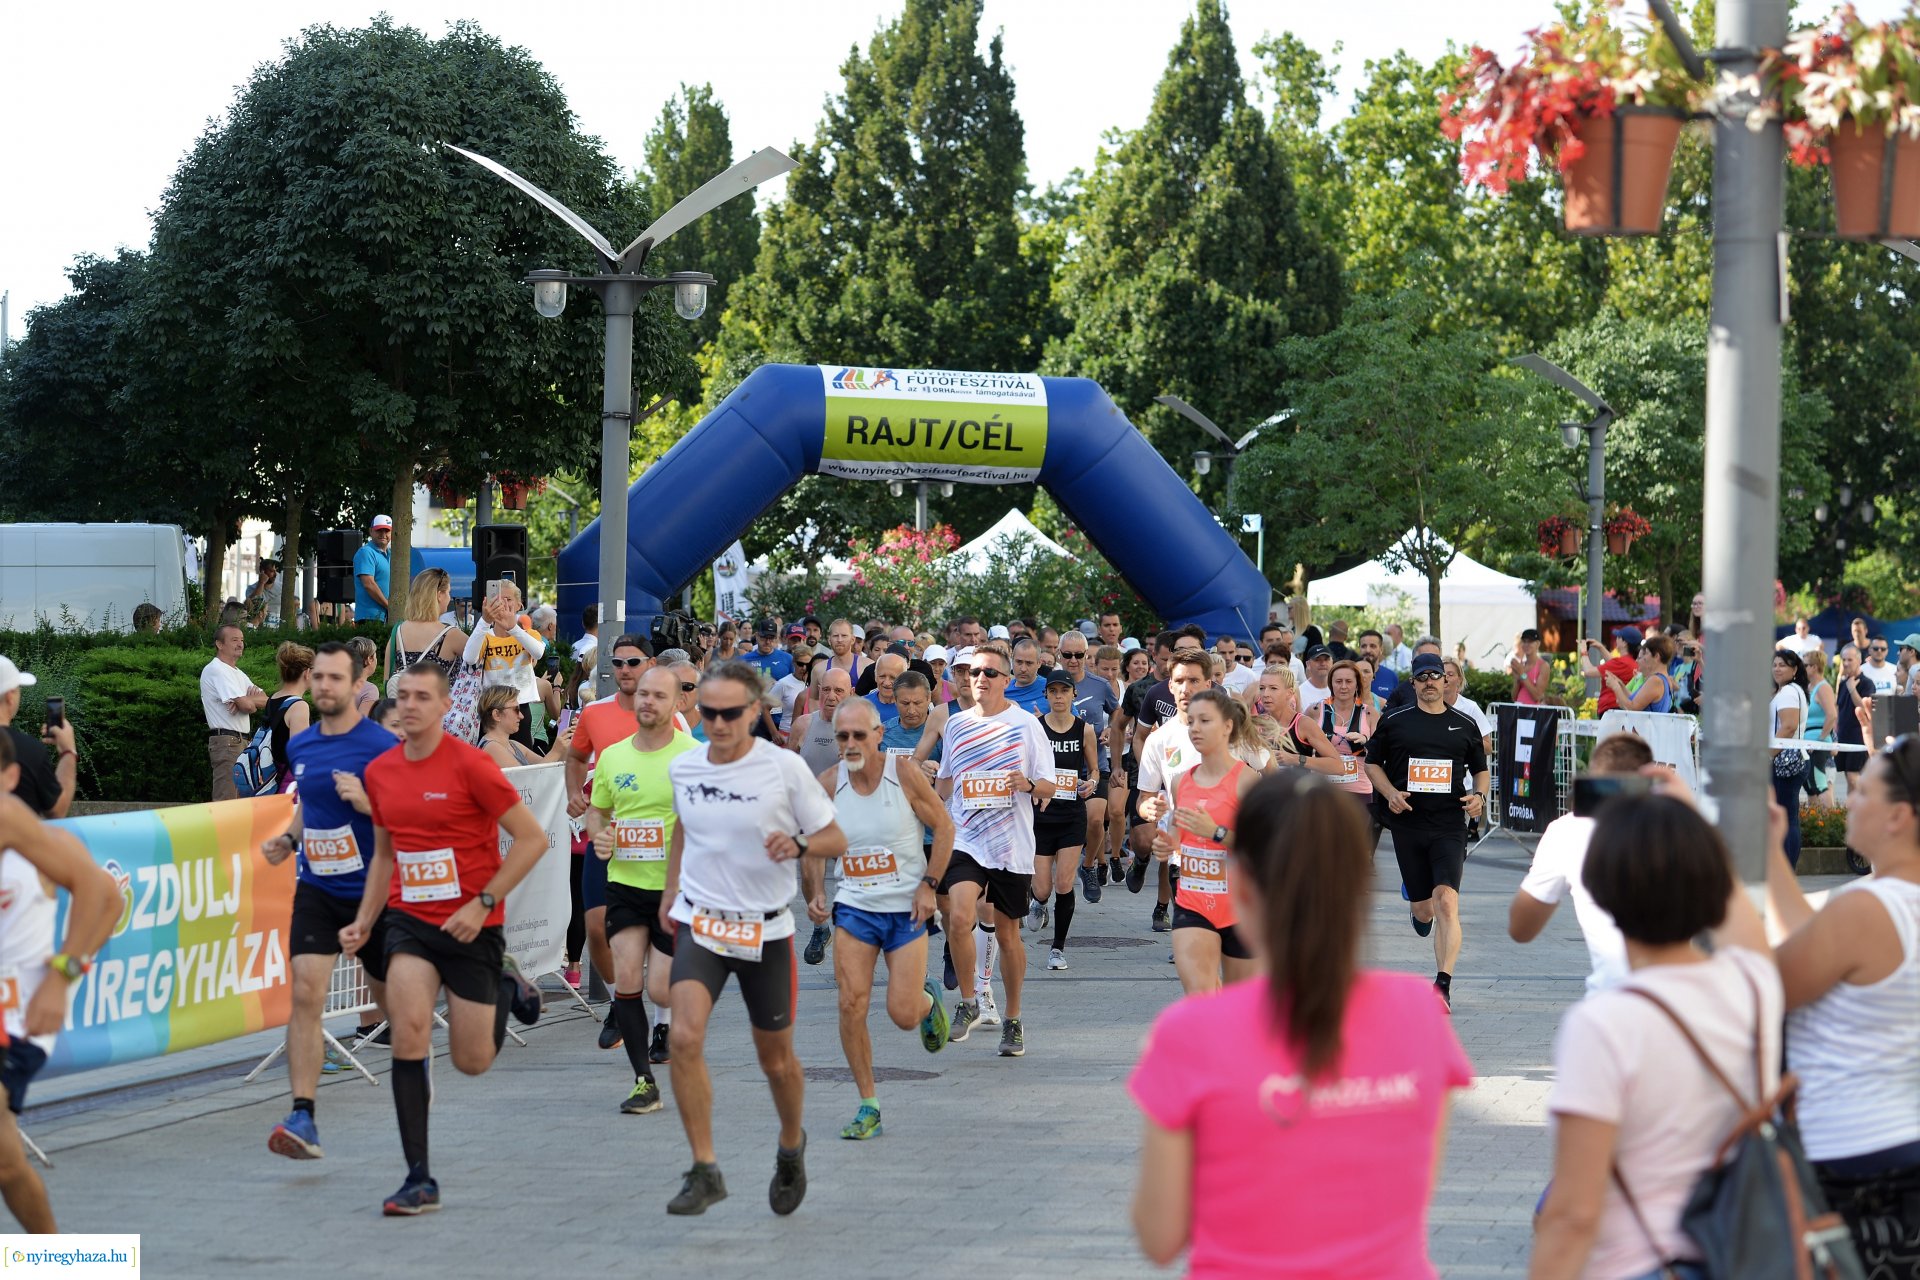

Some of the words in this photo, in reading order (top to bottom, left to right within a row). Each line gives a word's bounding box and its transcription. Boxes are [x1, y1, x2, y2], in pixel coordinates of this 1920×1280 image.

[975, 389, 1036, 398] támogatásával
[846, 413, 1024, 452] RAJT/CÉL
[1413, 766, 1448, 779] 1124
[966, 779, 1006, 793] 1078
[619, 828, 658, 843] 1023
[307, 838, 351, 856] 1093
[402, 861, 449, 881] 1129
[845, 855, 890, 872] 1145
[1183, 857, 1221, 875] 1068
[699, 917, 756, 941] 1025
